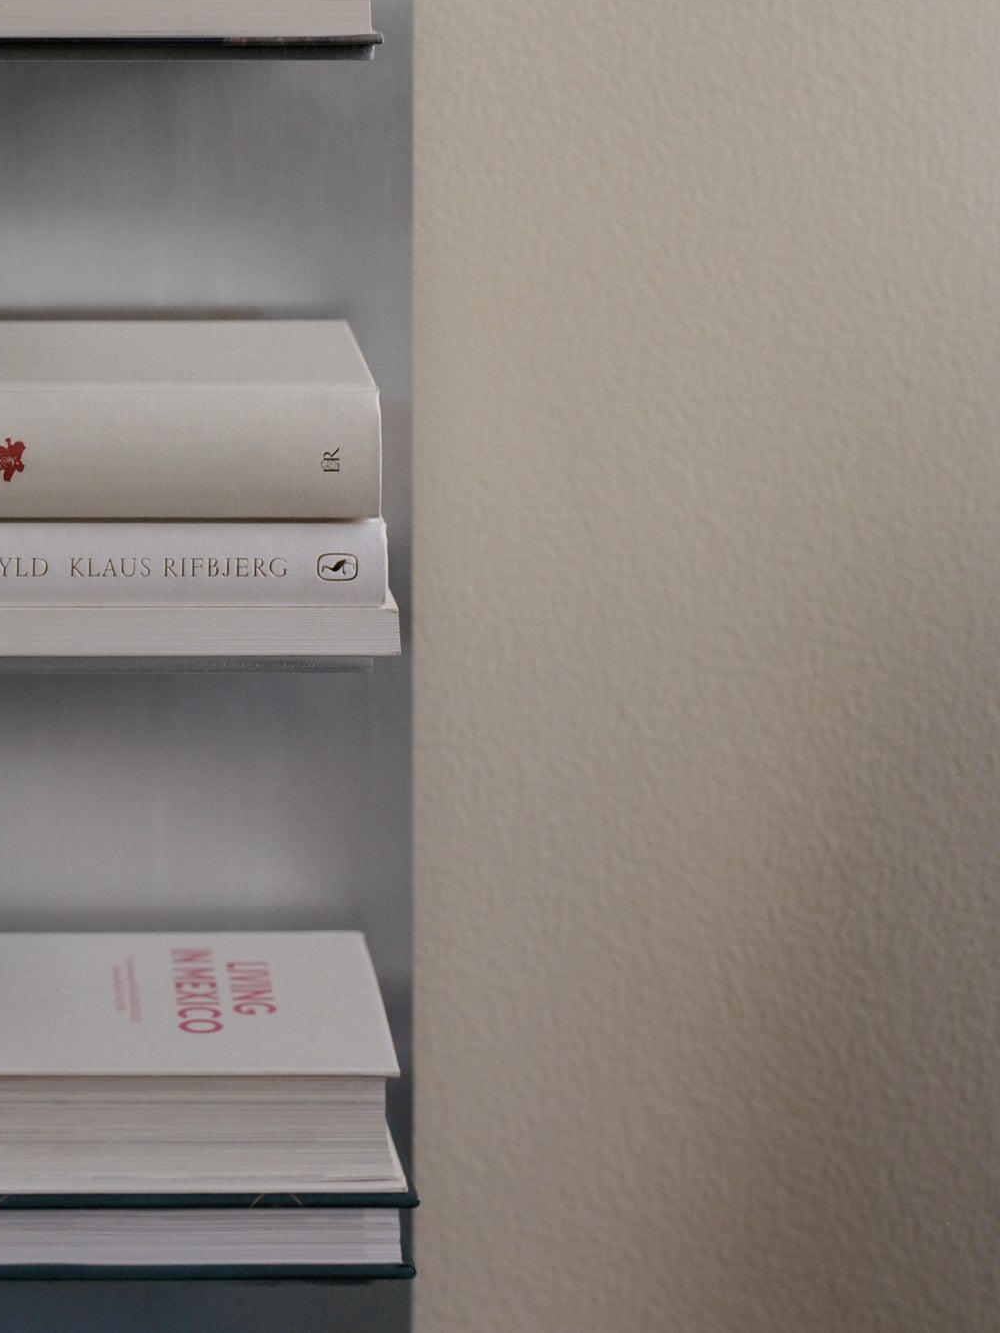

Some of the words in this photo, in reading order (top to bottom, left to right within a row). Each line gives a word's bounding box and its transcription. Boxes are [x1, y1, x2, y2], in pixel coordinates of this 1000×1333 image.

[69, 557, 151, 578] KLAUS
[163, 557, 288, 578] RIFBJERG
[172, 967, 223, 1034] MEXICO
[227, 961, 277, 1015] LIVING
